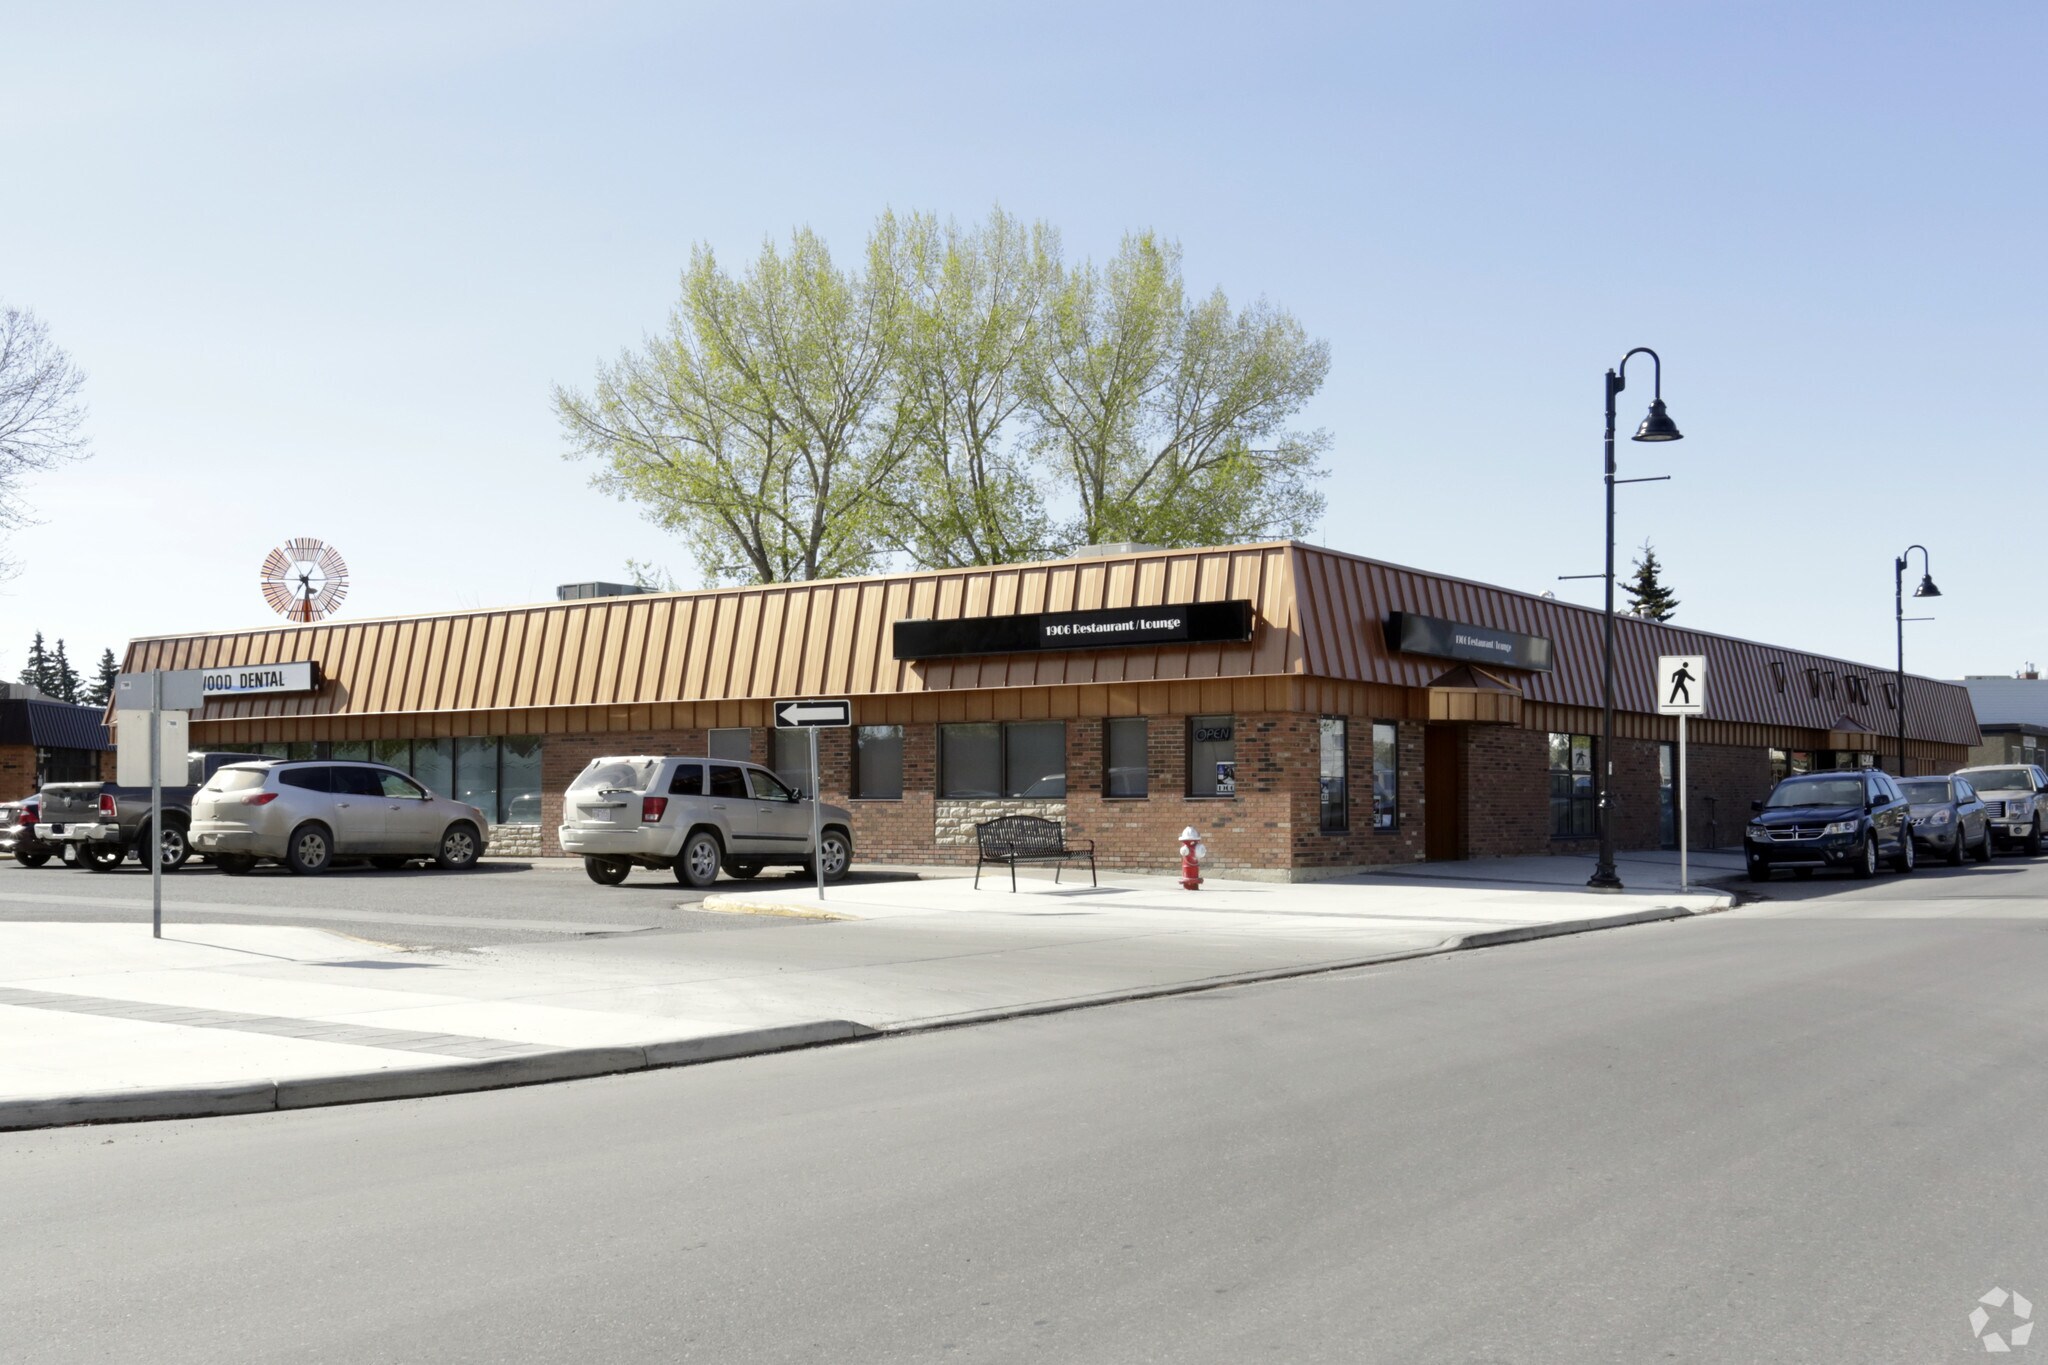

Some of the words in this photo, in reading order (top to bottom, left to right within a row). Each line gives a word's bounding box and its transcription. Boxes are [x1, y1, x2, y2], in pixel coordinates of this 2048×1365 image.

[1046, 624, 1071, 636] 1906
[1073, 620, 1134, 634] Restaurant
[1140, 618, 1181, 630] Lounge
[203, 674, 232, 691] OOD
[240, 671, 285, 689] DENTAL
[1196, 728, 1229, 741] OPEN
